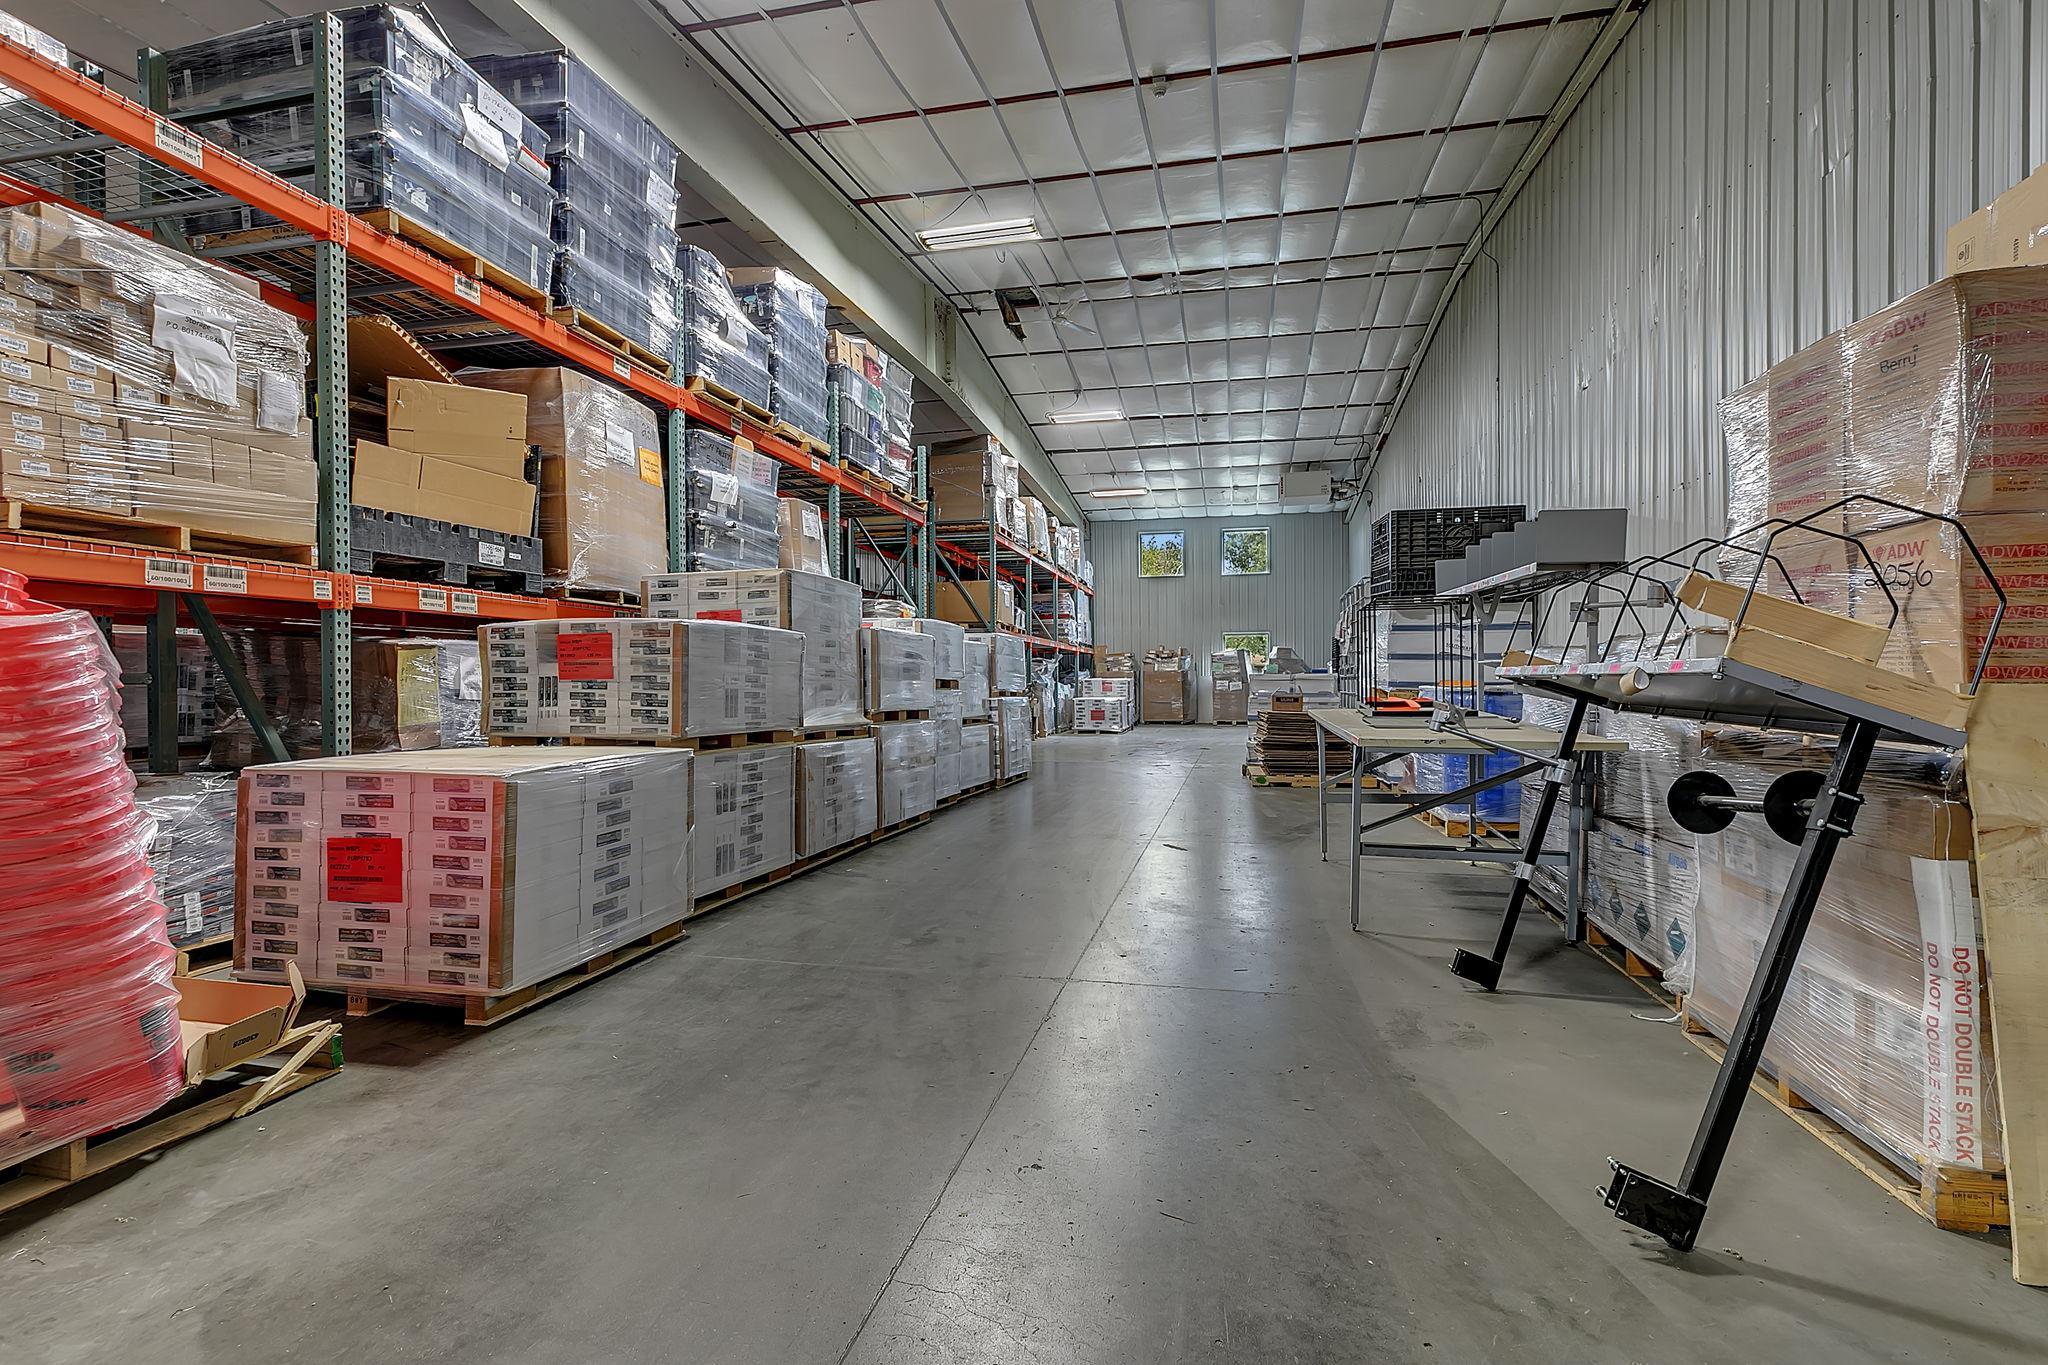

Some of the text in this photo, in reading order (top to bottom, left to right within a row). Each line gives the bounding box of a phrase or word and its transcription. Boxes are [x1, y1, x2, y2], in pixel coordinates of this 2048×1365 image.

[186, 316, 211, 330] Storage
[1880, 310, 1927, 343] ADW
[1880, 353, 1917, 374] Berry
[1887, 539, 1925, 561] ADW
[151, 575, 188, 584] 60/100/1003
[208, 580, 242, 589] 60/100/1002
[1926, 941, 1942, 1153] DO NOT DOUBLE STACK
[1953, 947, 1974, 1163] DO NOT DOUBLE STACK
